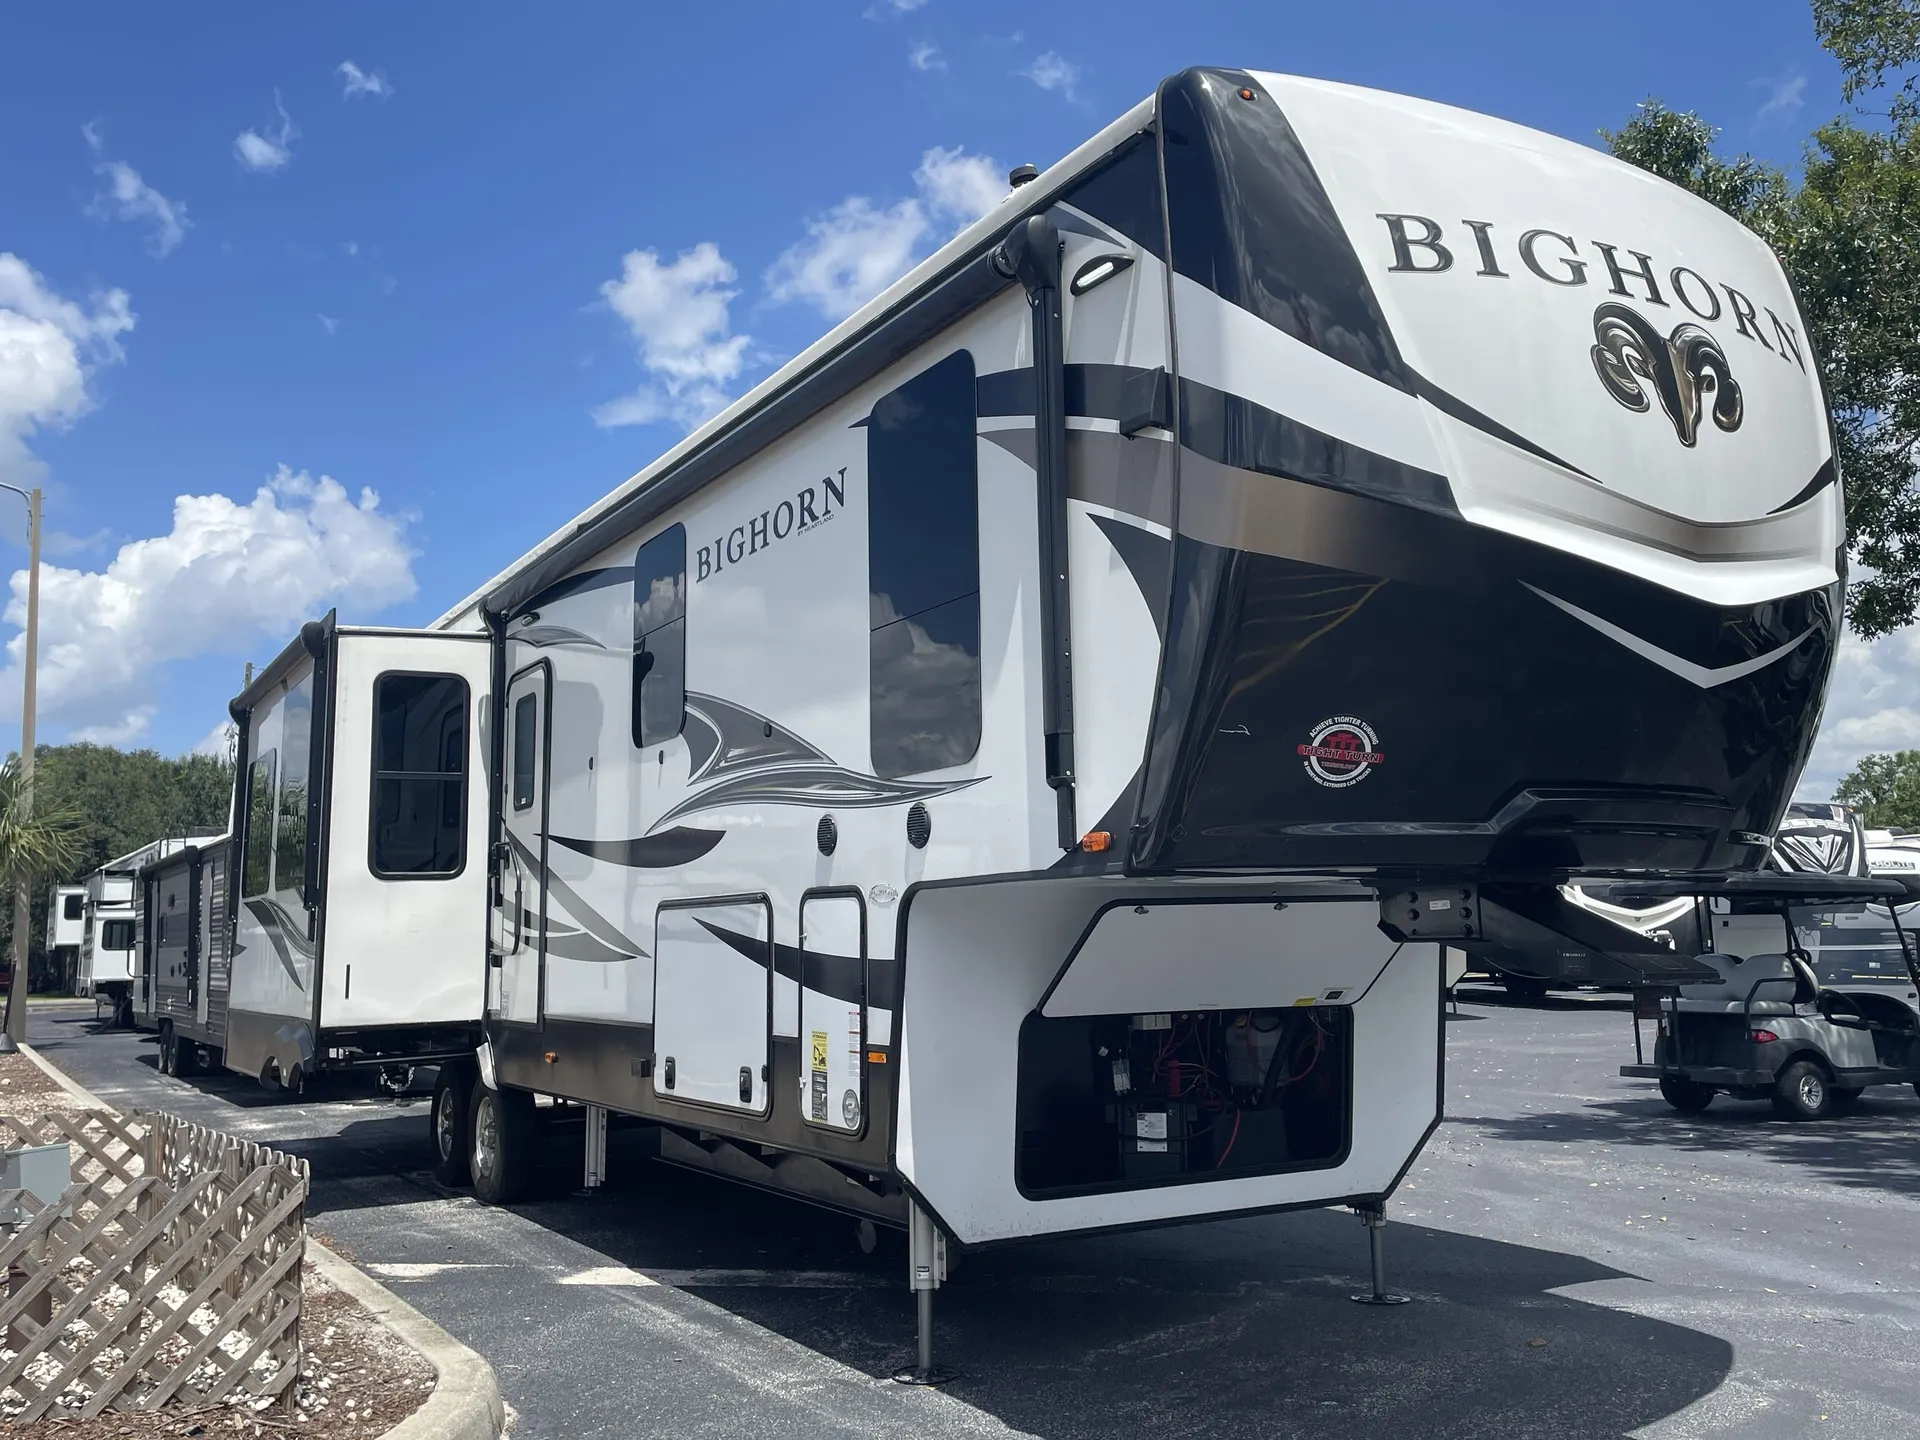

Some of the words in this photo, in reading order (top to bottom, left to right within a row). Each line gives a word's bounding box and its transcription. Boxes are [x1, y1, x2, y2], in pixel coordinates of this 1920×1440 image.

[1375, 212, 1807, 376] BIGHORN
[696, 466, 848, 584] BIGHORN
[804, 513, 835, 533] HEARTLAND
[1309, 717, 1334, 738] ACHIEVE
[1334, 716, 1361, 726] TIGHTER
[1361, 721, 1379, 746] TURNING
[1301, 744, 1342, 760] TIGHT
[1344, 750, 1380, 763] TURN
[1347, 779, 1357, 787] CAB
